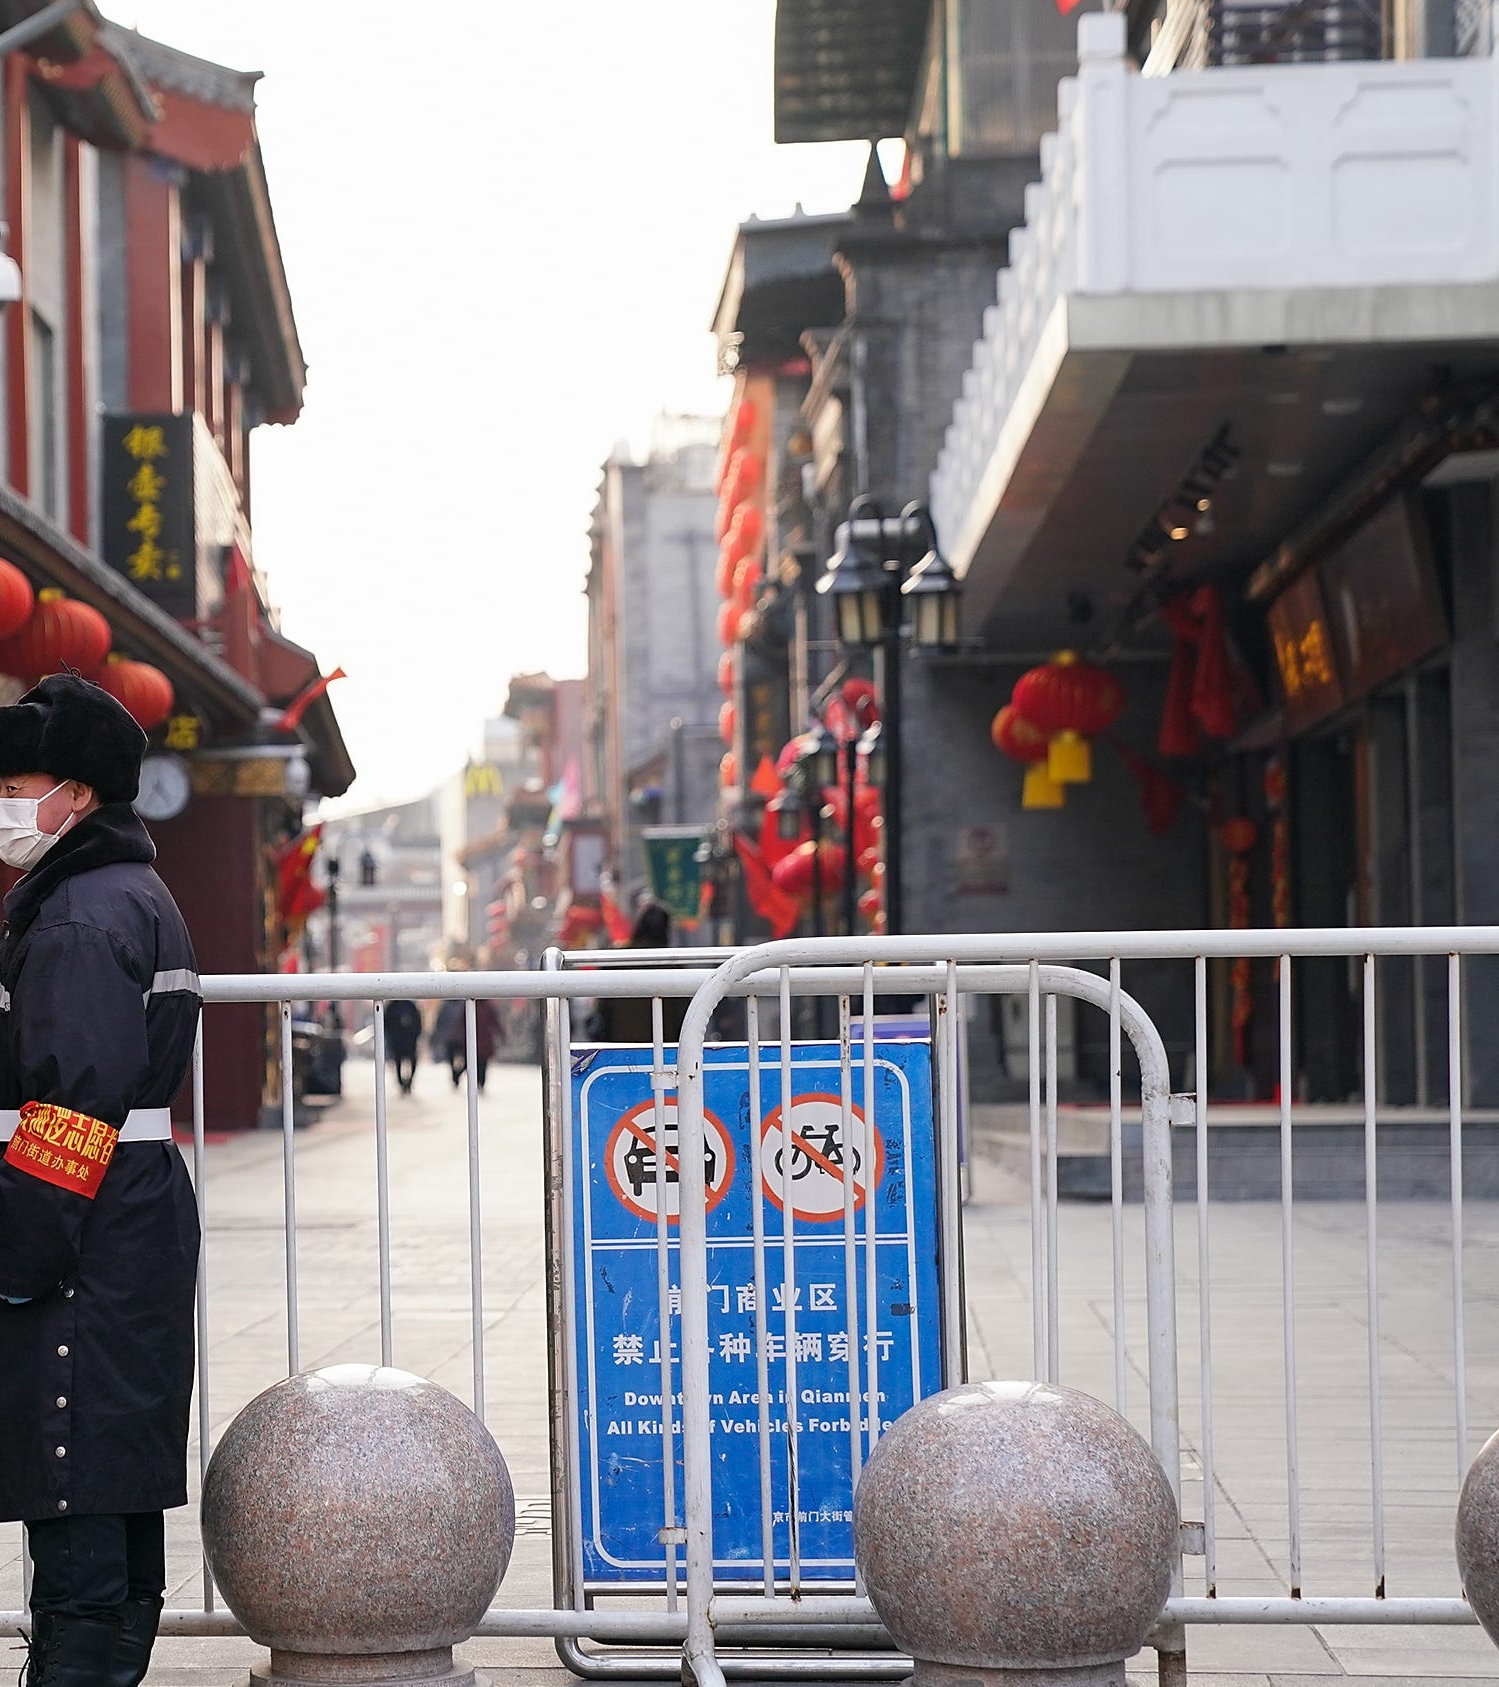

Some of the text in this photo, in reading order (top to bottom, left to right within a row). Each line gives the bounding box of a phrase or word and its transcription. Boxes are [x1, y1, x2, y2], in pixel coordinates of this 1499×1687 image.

[10, 1133, 91, 1182] 前门街道办事处
[612, 1331, 894, 1366] 禁止种车辆穿行
[624, 1391, 724, 1406] Dowtn
[606, 1421, 633, 1435] All
[638, 1420, 685, 1434] Kid
[808, 1417, 893, 1432] Forbde
